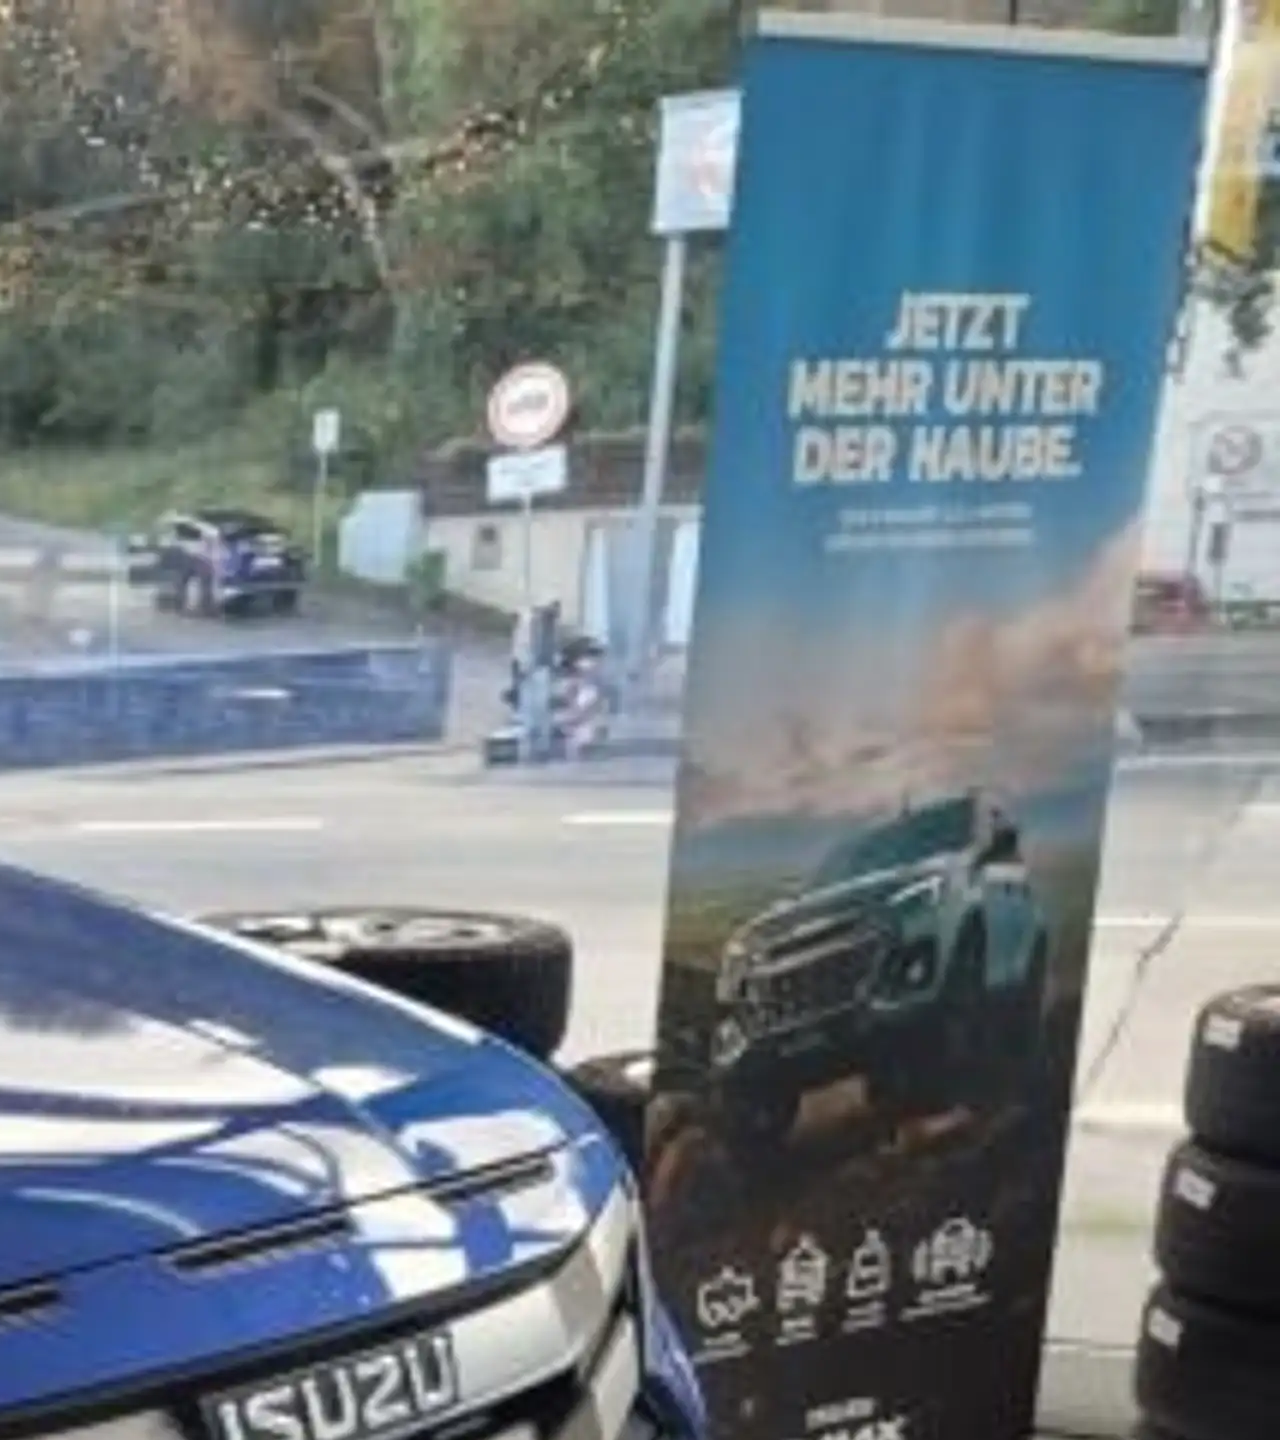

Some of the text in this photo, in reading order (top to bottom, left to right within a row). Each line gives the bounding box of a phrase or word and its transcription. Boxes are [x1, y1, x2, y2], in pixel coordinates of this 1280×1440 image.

[885, 290, 1032, 351] JETZT
[788, 358, 1102, 418] MEHR UNTER
[793, 424, 898, 483] DER
